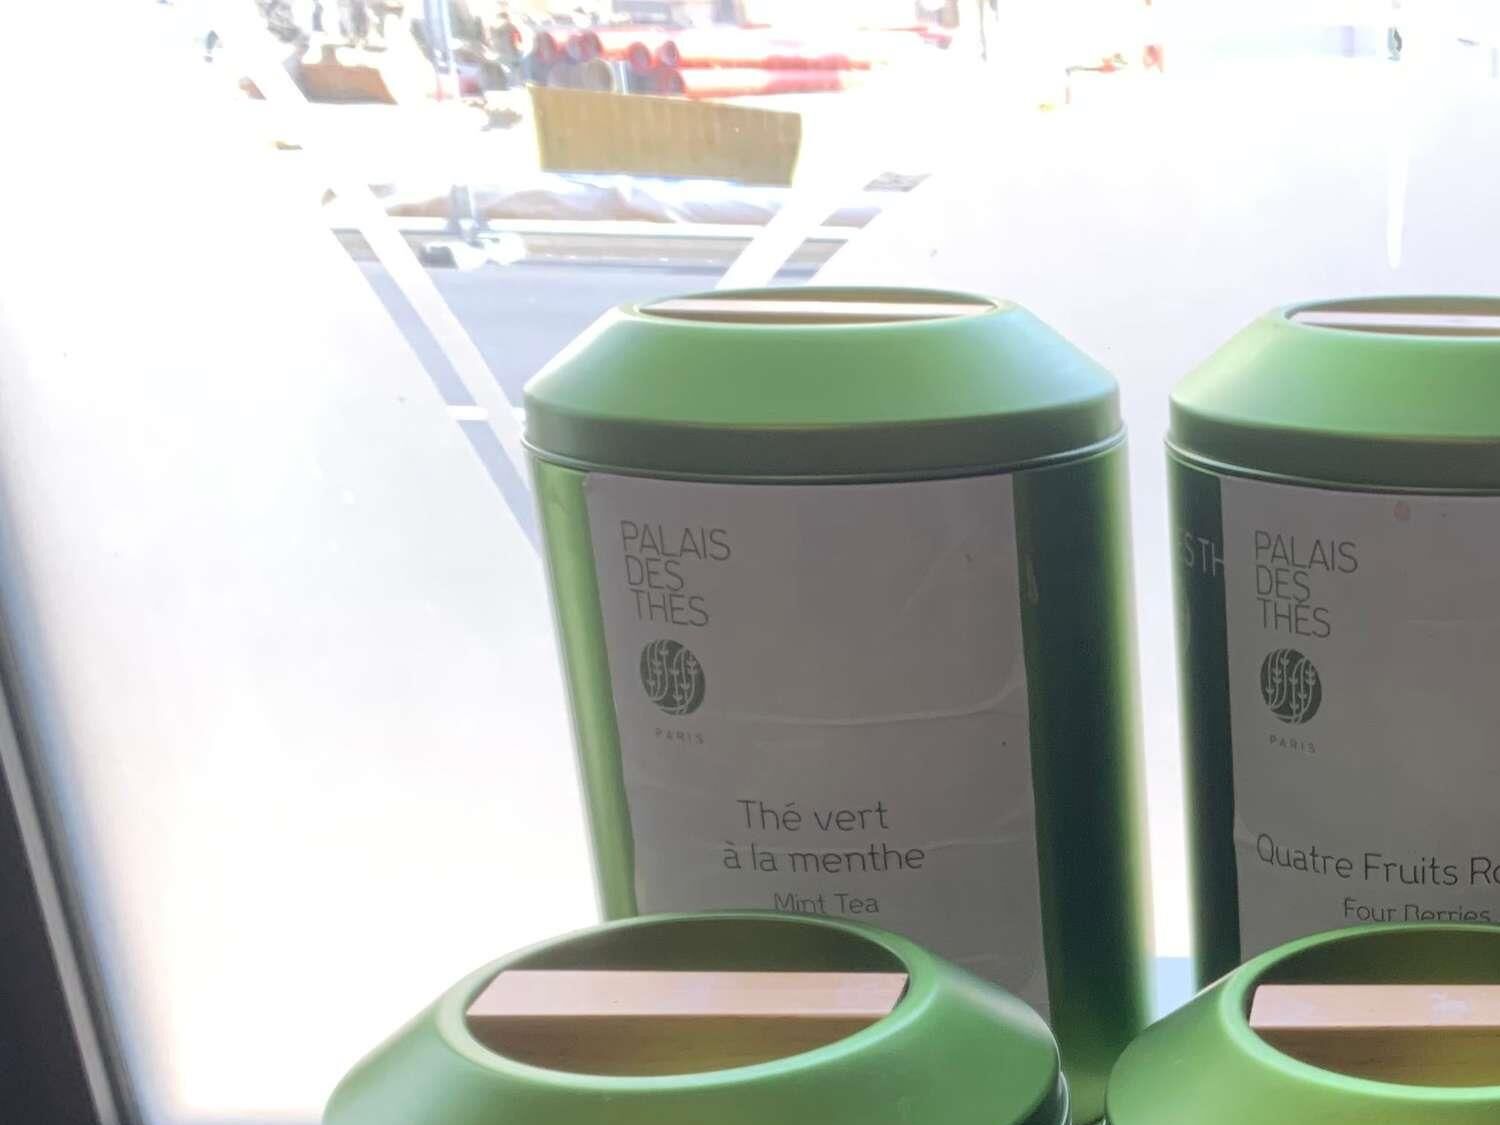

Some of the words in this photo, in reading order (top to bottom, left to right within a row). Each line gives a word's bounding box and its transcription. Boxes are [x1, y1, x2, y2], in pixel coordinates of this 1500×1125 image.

[620, 519, 731, 562] PALAIS
[1254, 529, 1358, 574] PALAIS
[624, 554, 684, 592] DES
[1256, 564, 1310, 602] DES
[655, 727, 705, 744] PARIS
[1269, 734, 1317, 754] PARIS
[737, 799, 802, 832] Thé
[813, 800, 889, 831] vert
[722, 840, 742, 871] à
[751, 843, 777, 873] la
[787, 842, 926, 873] menthe
[1256, 833, 1354, 879] Quatre
[1363, 853, 1458, 887] Fruits
[774, 892, 827, 914] Mint
[833, 892, 880, 914] Tea
[1343, 896, 1396, 922] Four
